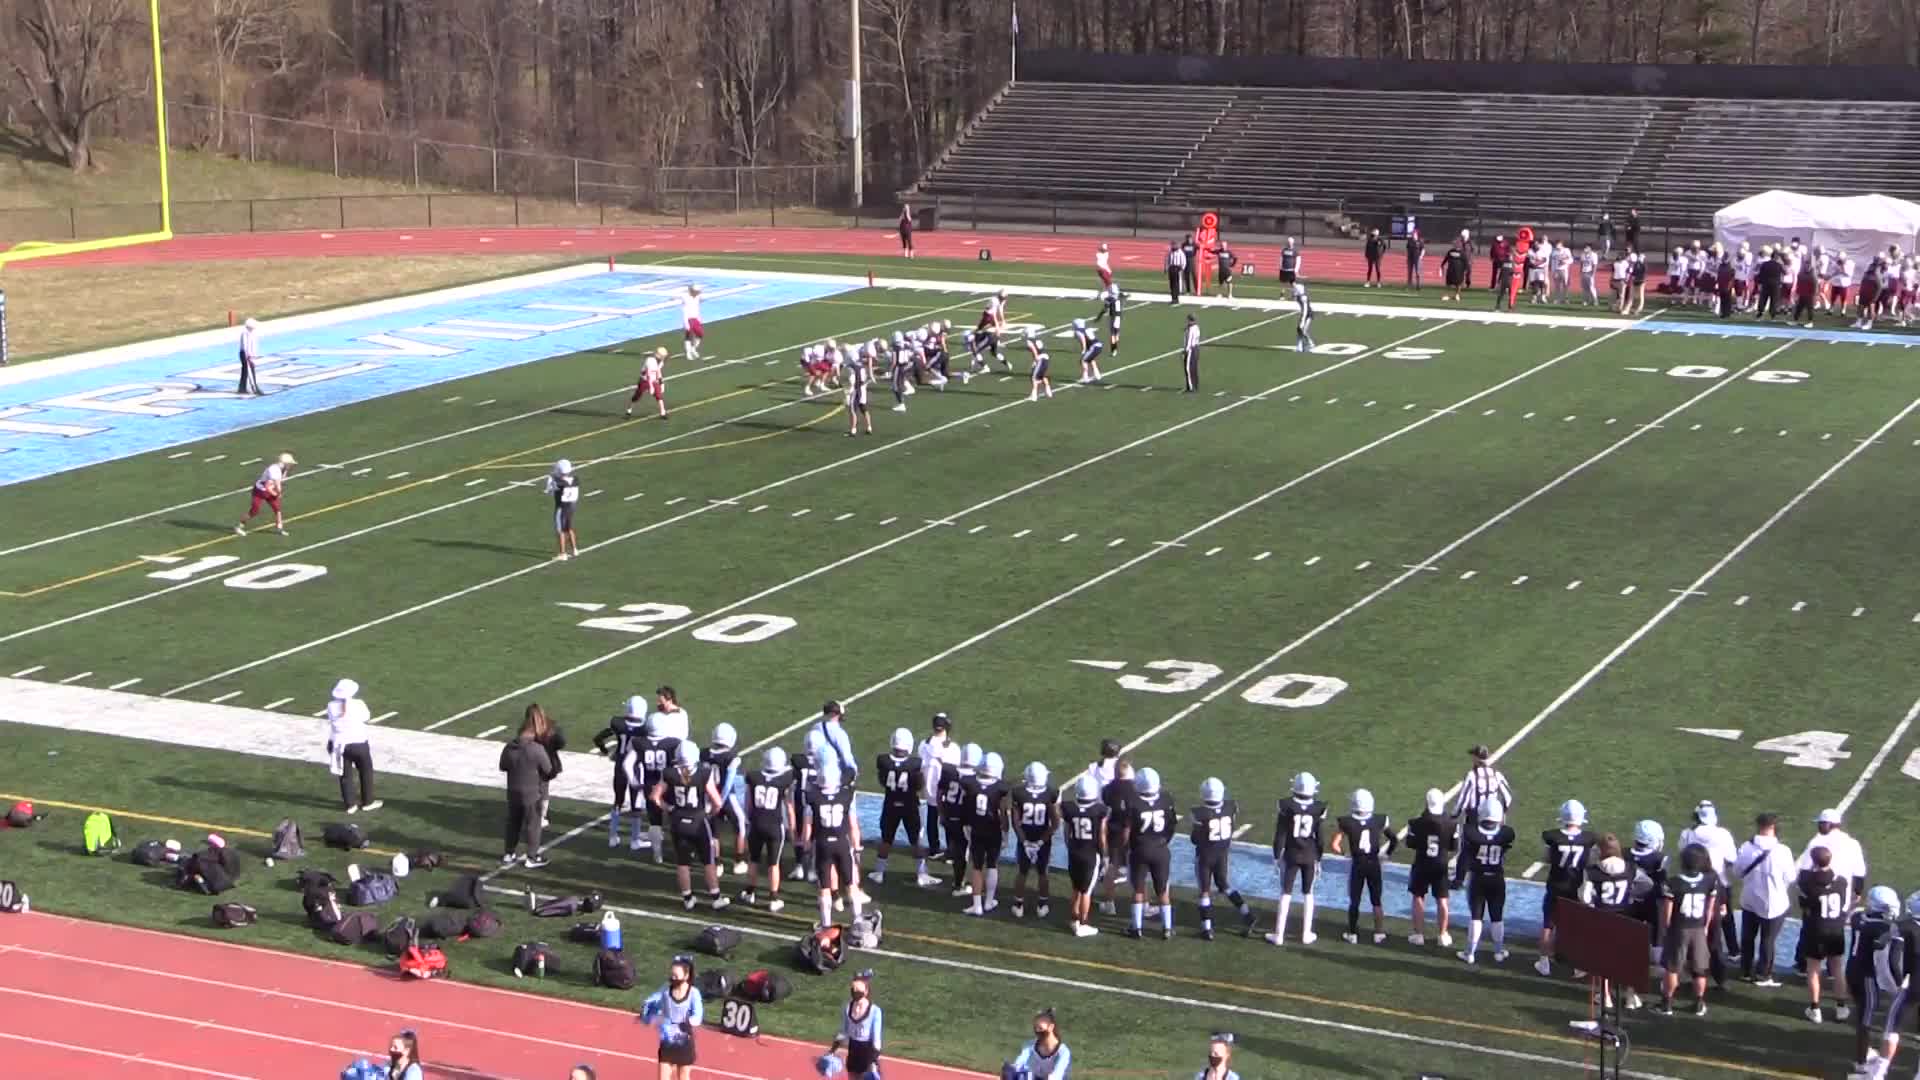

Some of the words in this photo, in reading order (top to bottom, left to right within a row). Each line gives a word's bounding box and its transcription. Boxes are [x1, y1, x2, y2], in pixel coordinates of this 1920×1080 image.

[1665, 365, 1811, 383] 30
[145, 555, 327, 589] 10
[576, 602, 798, 643] 20
[1115, 659, 1348, 708] 30
[644, 749, 667, 770] 99
[886, 770, 909, 792] 44
[674, 785, 699, 808] 54
[754, 785, 779, 810] 60
[1022, 802, 1047, 825] 20
[1140, 809, 1165, 833] 75
[1072, 817, 1093, 840] 12
[1293, 814, 1313, 838] 13
[1358, 829, 1371, 854] 4
[1426, 835, 1439, 857] 5
[1476, 844, 1501, 865] 40
[1558, 845, 1584, 868] 77
[1601, 879, 1628, 904] 27
[1680, 893, 1706, 919] 45
[1818, 892, 1841, 919] 19
[722, 1000, 751, 1032] 30
